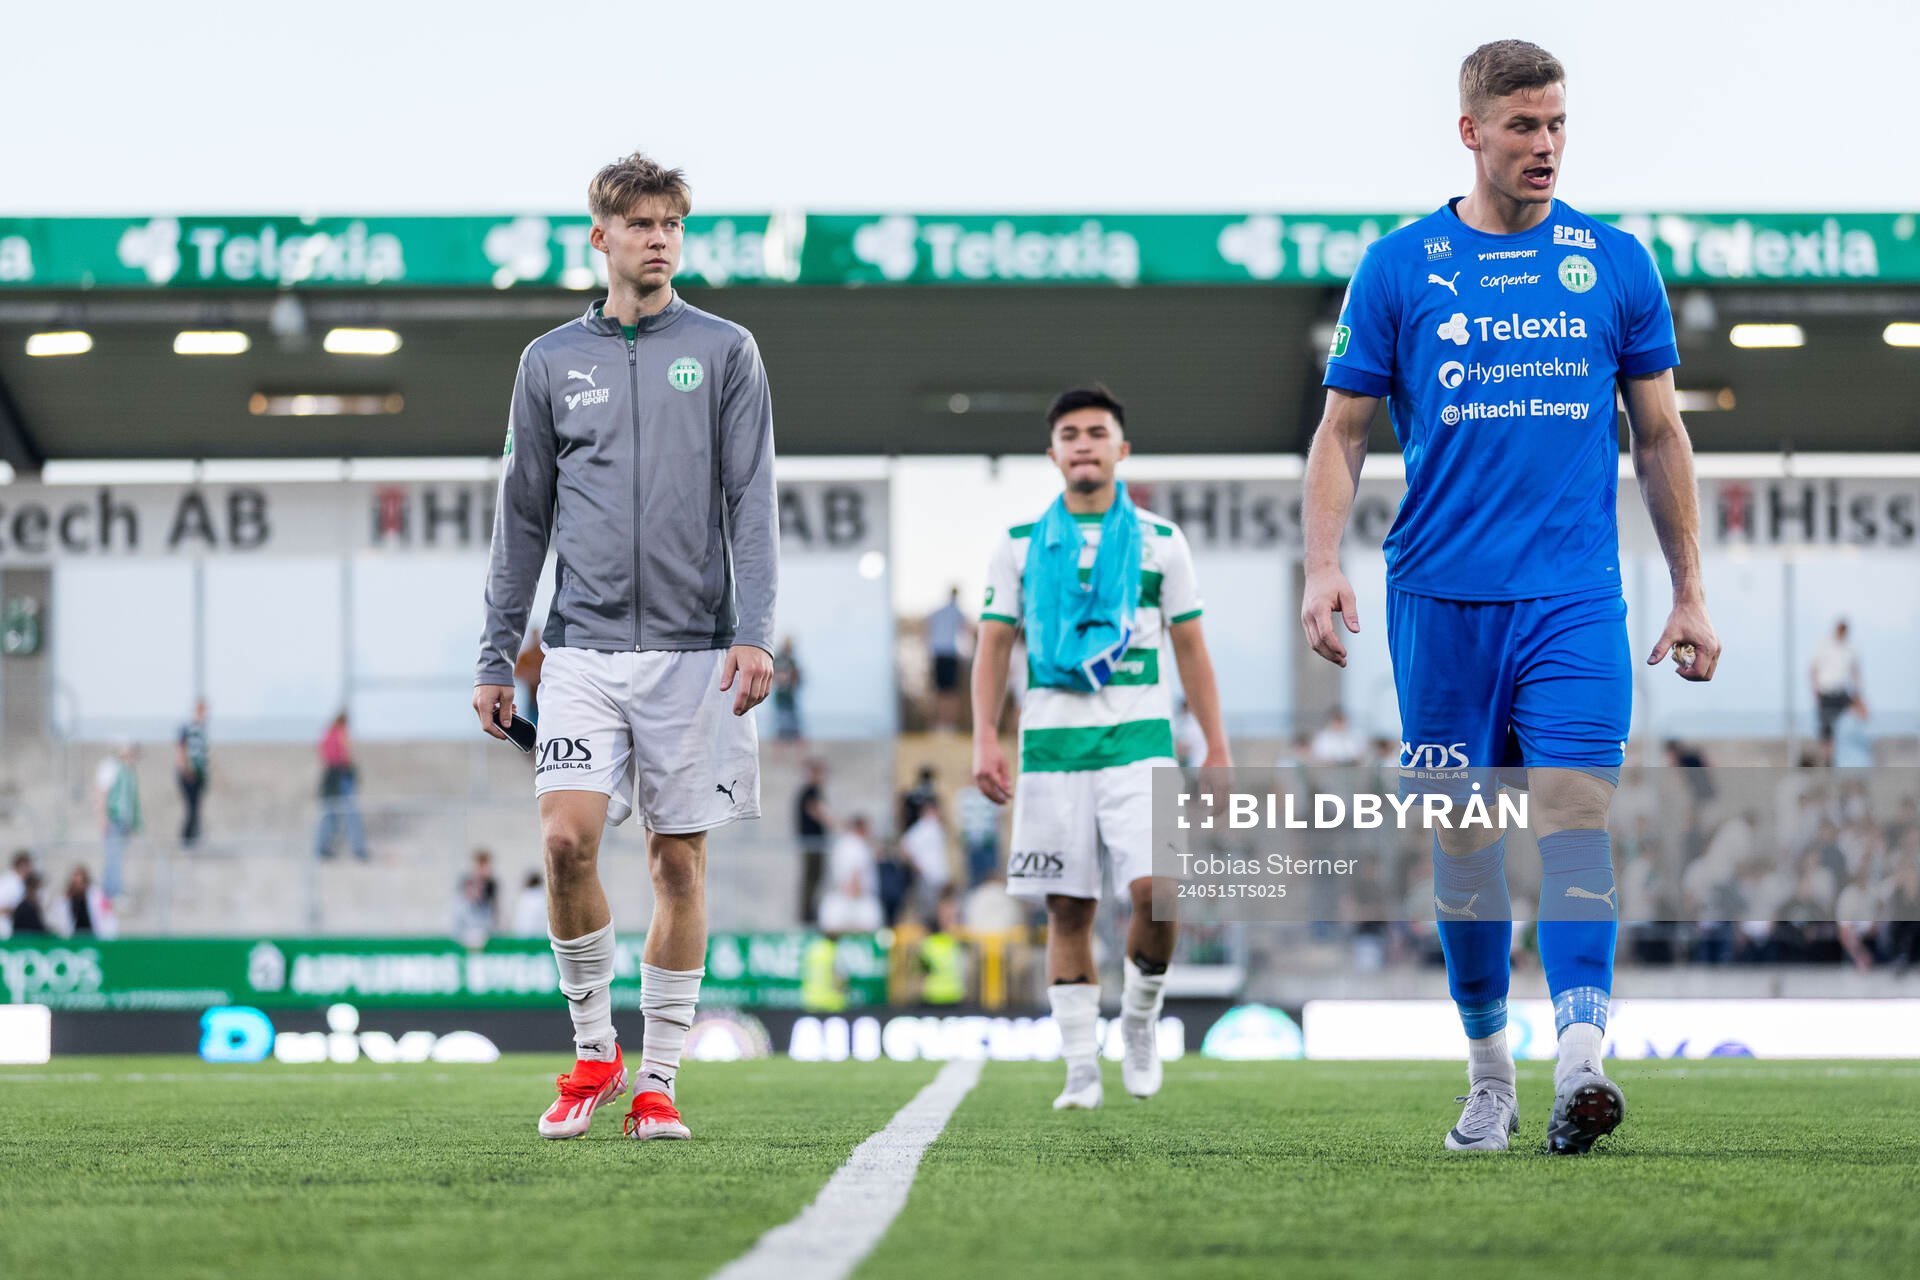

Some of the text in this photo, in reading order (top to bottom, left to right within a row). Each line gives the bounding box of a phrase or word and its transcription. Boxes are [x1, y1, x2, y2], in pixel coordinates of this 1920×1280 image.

[1553, 224, 1595, 243] SPOL
[922, 220, 1140, 281] Telexia
[1424, 241, 1452, 254] TAK
[1486, 250, 1538, 260] INTERSPORT
[1660, 217, 1878, 277] Telexia
[1480, 272, 1541, 293] Carpenter
[1474, 311, 1587, 341] Telexia
[581, 388, 610, 398] INTER
[582, 396, 609, 406] SPORT
[1461, 399, 1589, 420] Hitachi Energy
[0, 487, 270, 552] ech AB
[780, 487, 868, 546] AB
[536, 737, 592, 768] YDS
[546, 763, 591, 771] BILGLAS
[1417, 771, 1469, 779] BILGLAS
